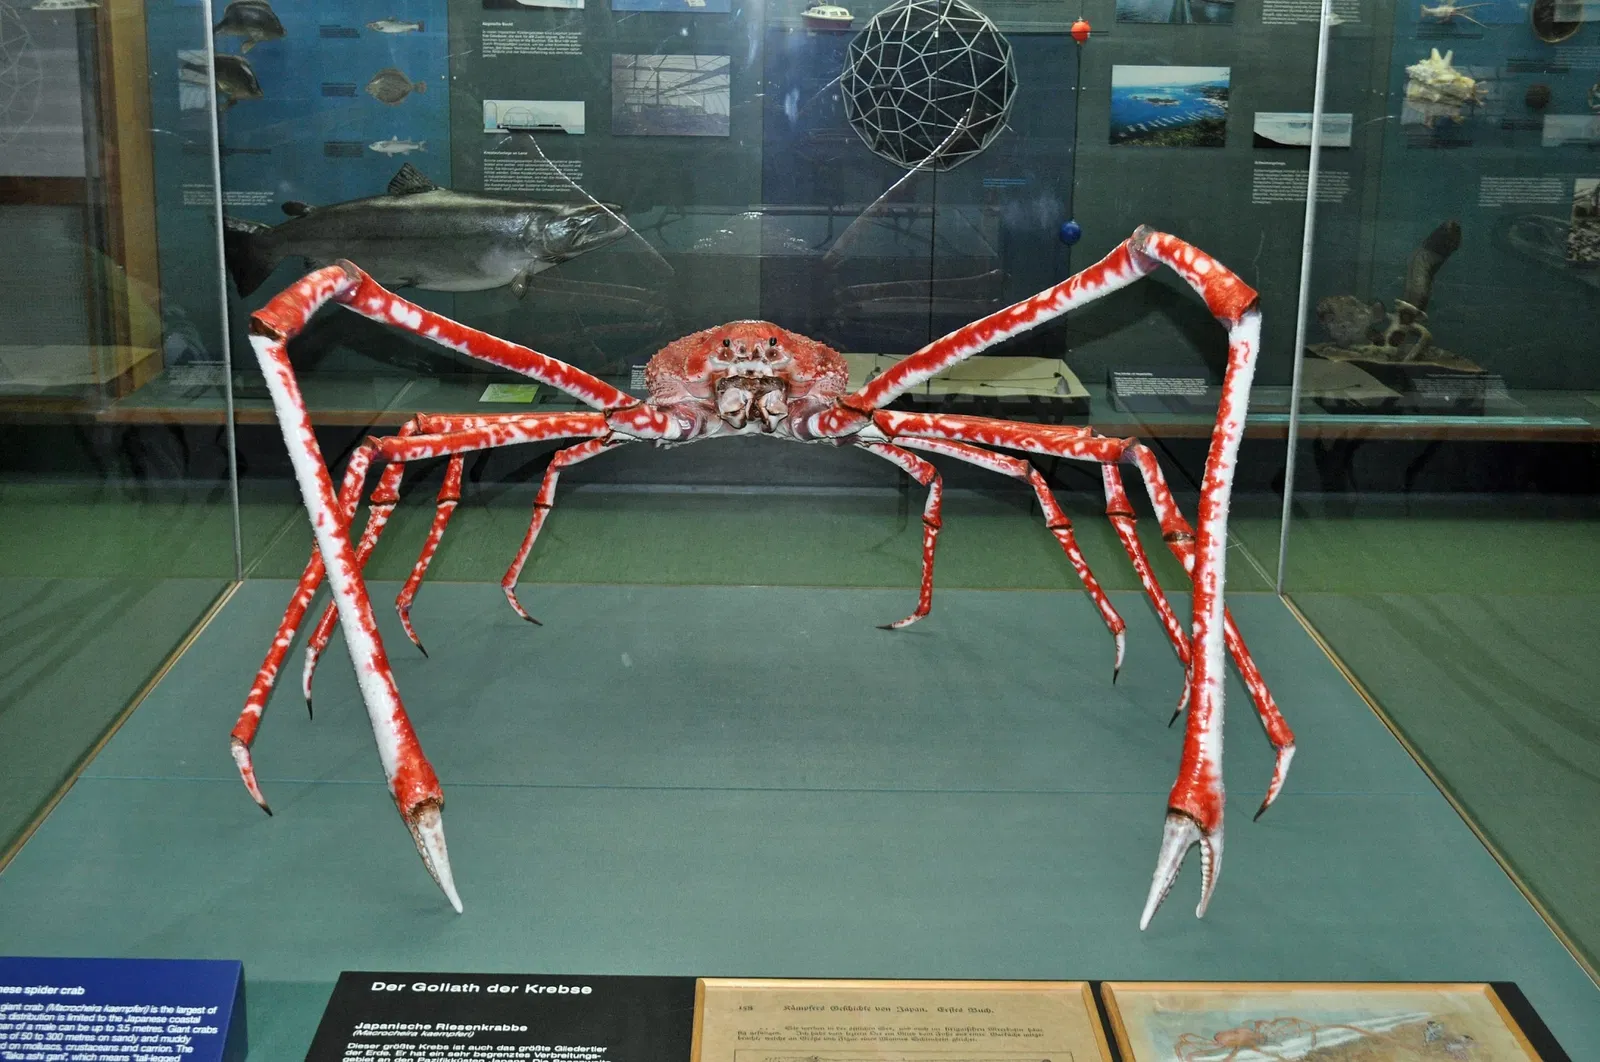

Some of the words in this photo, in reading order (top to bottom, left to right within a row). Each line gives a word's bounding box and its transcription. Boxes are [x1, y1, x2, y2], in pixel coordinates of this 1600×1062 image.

[24, 985, 59, 996] spider
[60, 986, 85, 995] crab
[371, 982, 406, 992] Der
[412, 982, 480, 993] Goliath
[487, 983, 519, 994] der
[525, 983, 592, 995] Krebse
[1, 1003, 22, 1012] giant
[24, 1003, 44, 1012] crab
[46, 1003, 102, 1013] (Macrocheira
[150, 1005, 158, 1013] is
[160, 1005, 174, 1014] the
[176, 1005, 206, 1015] largest
[207, 1006, 218, 1014] of
[8, 1012, 55, 1021] distribution
[57, 1013, 65, 1021] is
[67, 1013, 95, 1022] limited
[97, 1014, 107, 1022] to
[108, 1014, 123, 1022] the
[124, 1015, 167, 1024] Japanese
[169, 1015, 201, 1024] coastal
[15, 1021, 26, 1030] of
[35, 1022, 57, 1031] male
[58, 1023, 75, 1031] can
[77, 1023, 90, 1032] be
[91, 1024, 103, 1033] up
[105, 1024, 115, 1032] to
[167, 1025, 191, 1033] Giant
[192, 1025, 218, 1034] crabs
[355, 1022, 432, 1032] Japanische
[436, 1022, 528, 1032] Riesenkrabbe
[9, 1031, 20, 1040] of
[20, 1032, 33, 1040] 50
[34, 1033, 44, 1041] to
[45, 1032, 64, 1041] 300
[65, 1033, 96, 1042] metres
[98, 1034, 110, 1042] on
[111, 1034, 139, 1044] sandy
[140, 1034, 159, 1042] and
[160, 1034, 192, 1045] muddy
[65, 1043, 119, 1052] crustaceans
[121, 1044, 139, 1052] and
[140, 1044, 173, 1053] carrion.
[175, 1044, 194, 1053] The
[347, 1042, 380, 1050] Dieser
[383, 1042, 416, 1051] größte
[418, 1043, 449, 1051] Krebs
[452, 1043, 465, 1051] ist
[497, 1044, 515, 1052] das
[518, 1044, 551, 1053] größte
[554, 1045, 608, 1053] Gliedertier
[26, 1052, 45, 1060] ashi
[71, 1053, 98, 1062] which
[99, 1054, 130, 1062] means
[345, 1049, 363, 1057] der
[365, 1049, 391, 1057] Erde.
[395, 1049, 407, 1057] Er
[409, 1050, 426, 1058] hat
[429, 1050, 444, 1058] ein
[473, 1051, 530, 1060] begrenztes
[533, 1052, 601, 1061] Verbreitungs-
